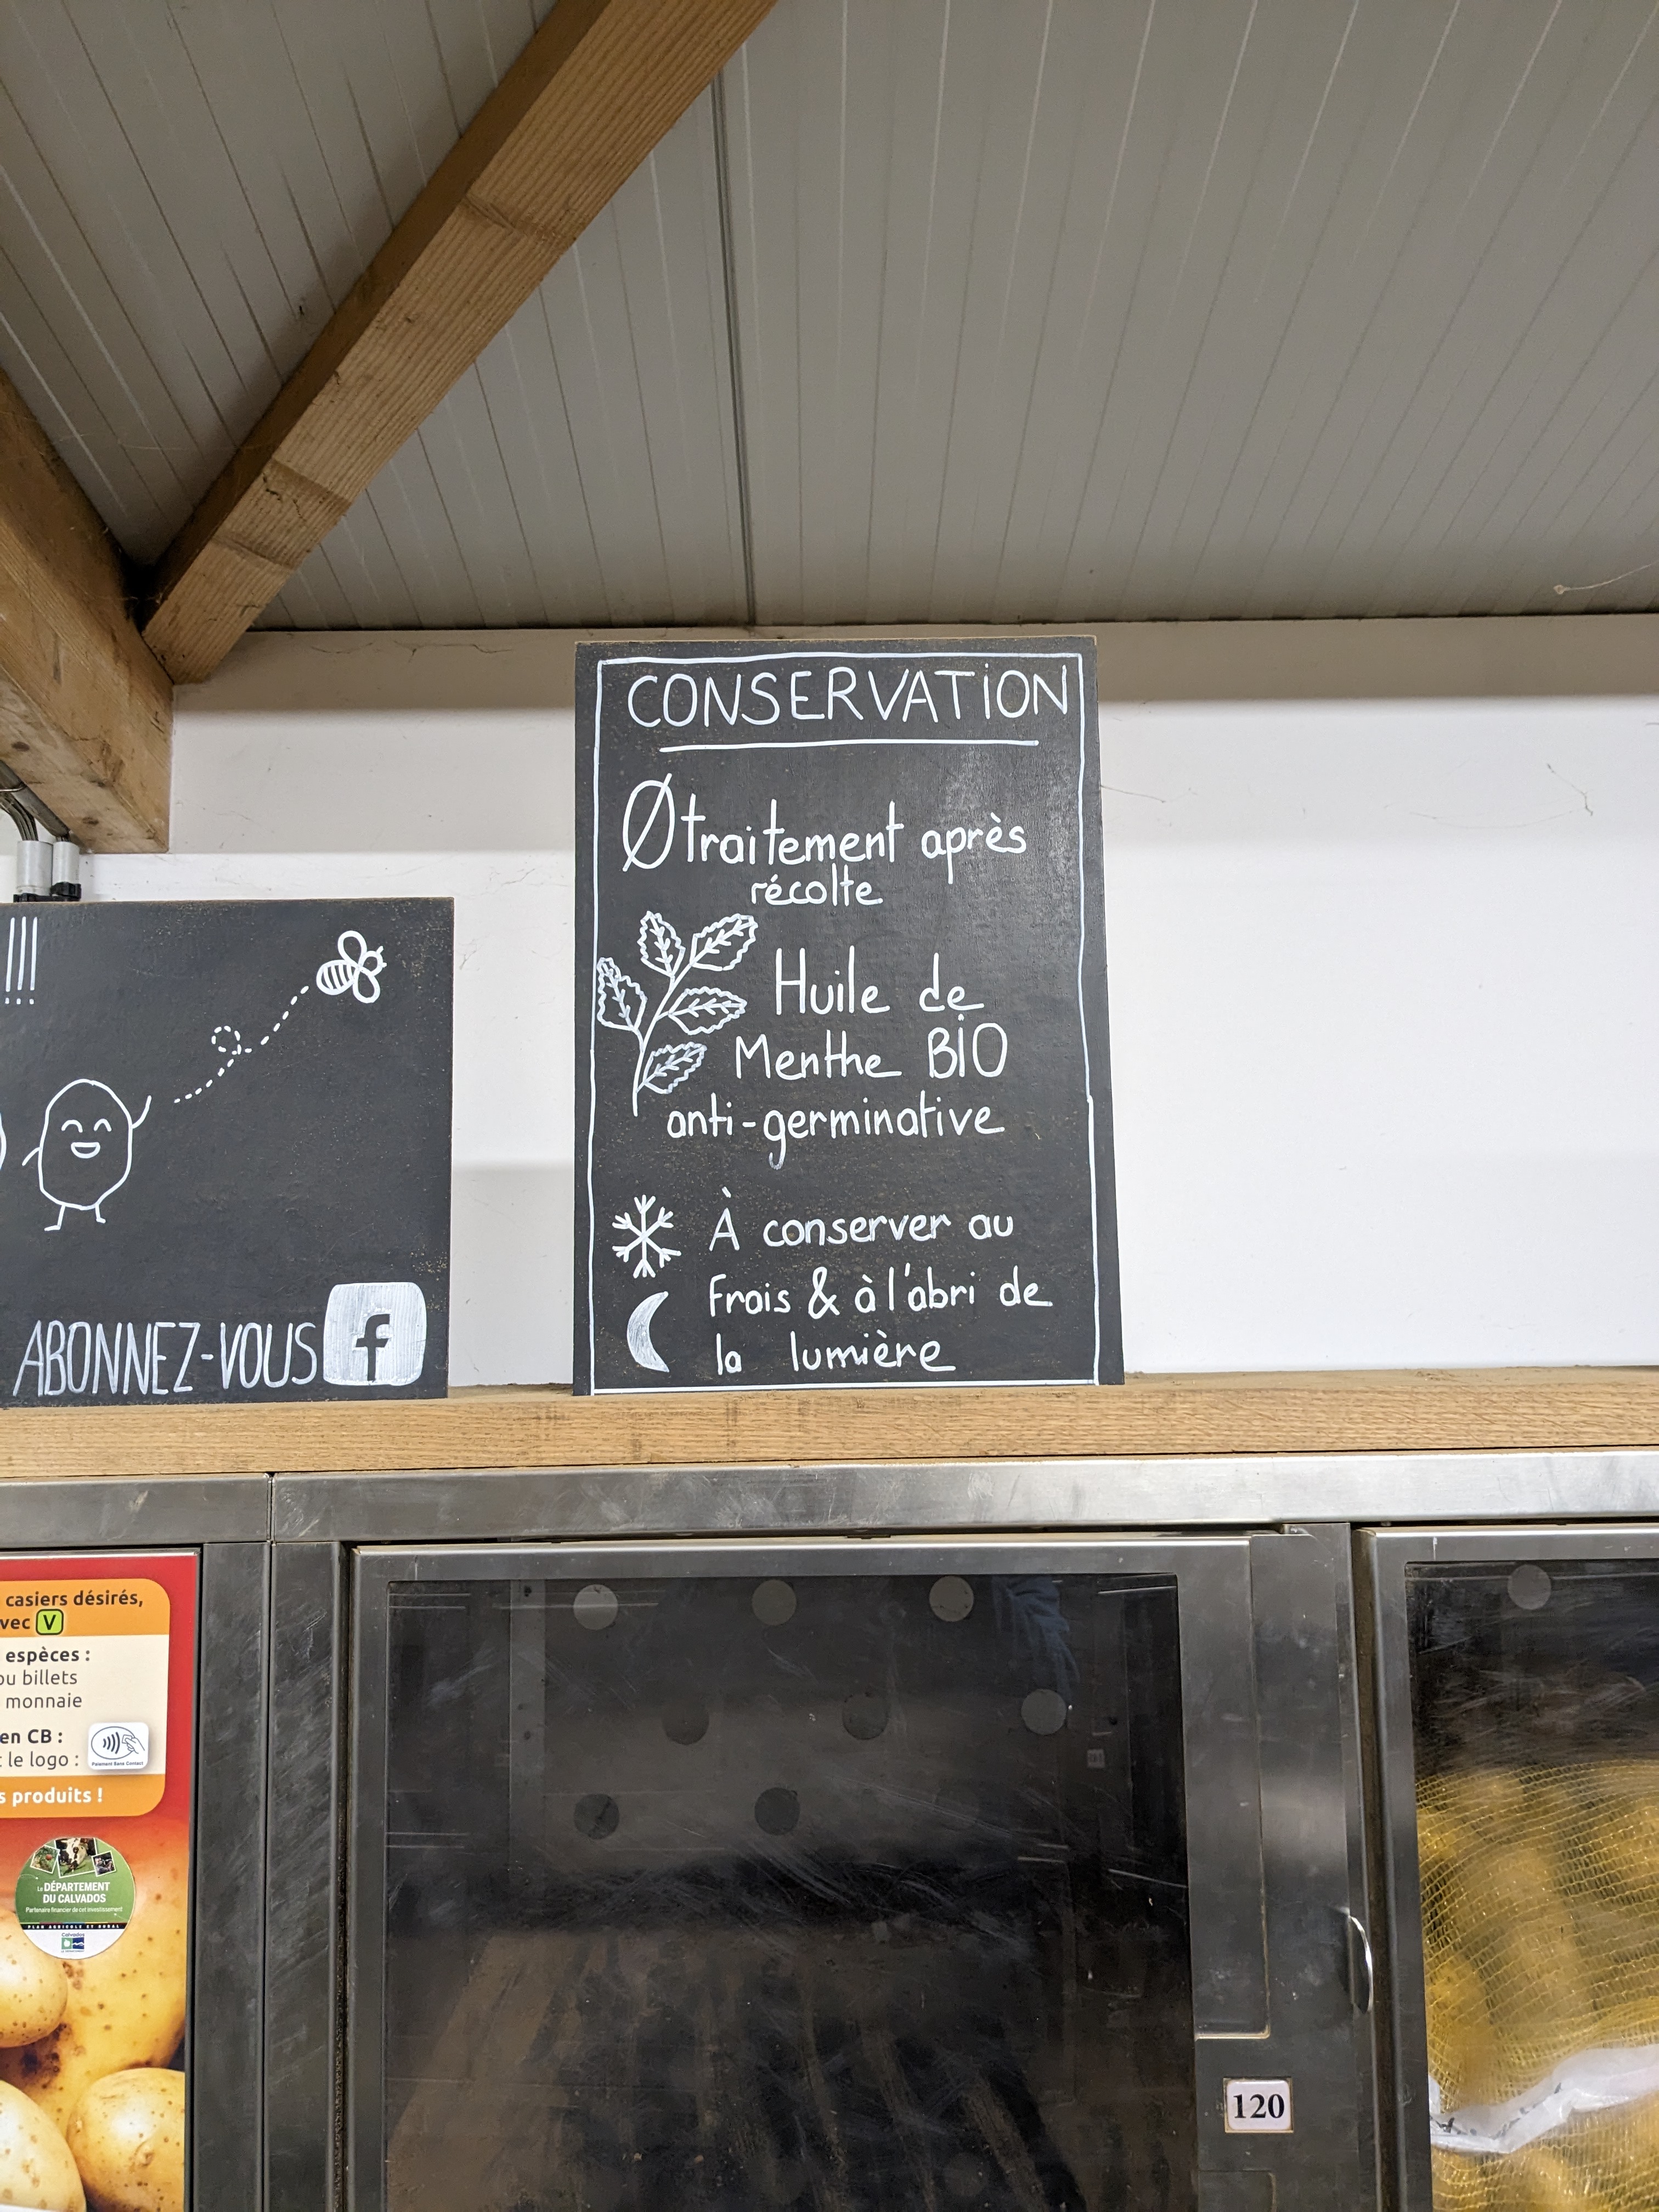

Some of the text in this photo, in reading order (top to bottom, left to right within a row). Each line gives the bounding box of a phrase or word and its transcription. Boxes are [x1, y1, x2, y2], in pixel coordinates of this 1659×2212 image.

[680, 793, 905, 865] traitement
[921, 811, 1027, 885] après
[751, 864, 883, 907] récolte
[775, 945, 985, 1015] Huile de
[736, 1029, 902, 1081] Menthe
[667, 1090, 1005, 1170] anti-germinative
[709, 1186, 1013, 1251] À conserver au
[808, 1266, 840, 1319] &
[999, 1265, 1053, 1307] de
[13, 1320, 317, 1397] ABONNEZ-VOUS
[716, 1329, 956, 1375] la lumière
[5, 1589, 143, 1607] casiers désirés,
[43, 1614, 57, 1630] V
[0, 1669, 77, 1685] ou billets
[6, 1692, 82, 1708] monnaie
[0, 1733, 20, 1744] en
[27, 1729, 52, 1744] CB
[9, 1751, 23, 1767] le
[30, 1751, 69, 1770] logo
[12, 1786, 92, 1807] produits
[43, 1894, 106, 1903] DU CALVADOS
[44, 1881, 110, 1892] DÉPARTEMENT
[1233, 2094, 1285, 2119] 120
